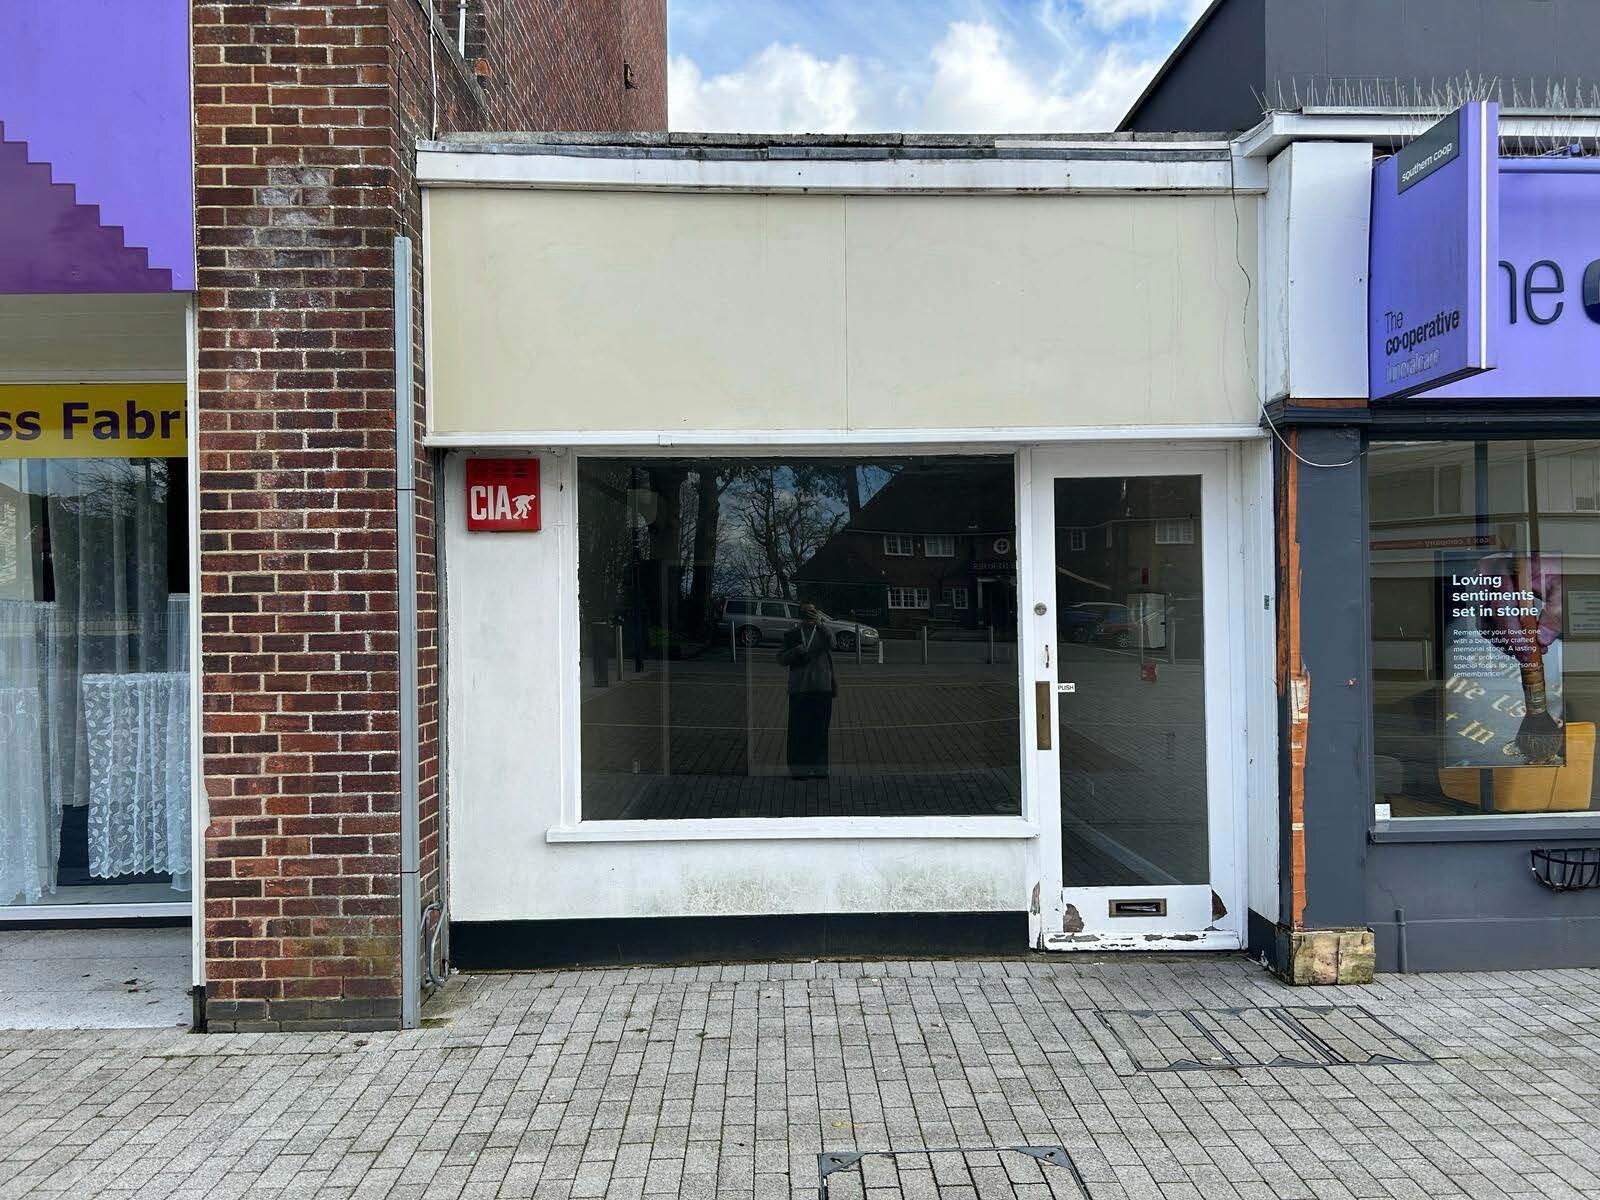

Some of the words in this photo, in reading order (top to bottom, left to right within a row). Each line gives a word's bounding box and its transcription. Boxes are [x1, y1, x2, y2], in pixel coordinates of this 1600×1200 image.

[1433, 142, 1453, 161] coop
[1385, 311, 1403, 334] The
[63, 400, 188, 440] Fabr
[470, 485, 513, 520] CIA
[1452, 574, 1502, 588] Loving
[1452, 589, 1534, 602] sentiments
[1452, 606, 1476, 617] set
[1480, 605, 1493, 617] in
[1497, 605, 1539, 617] stone
[1474, 637, 1509, 645] beautifully
[1514, 645, 1537, 653] lasting
[1478, 654, 1511, 662] providing
